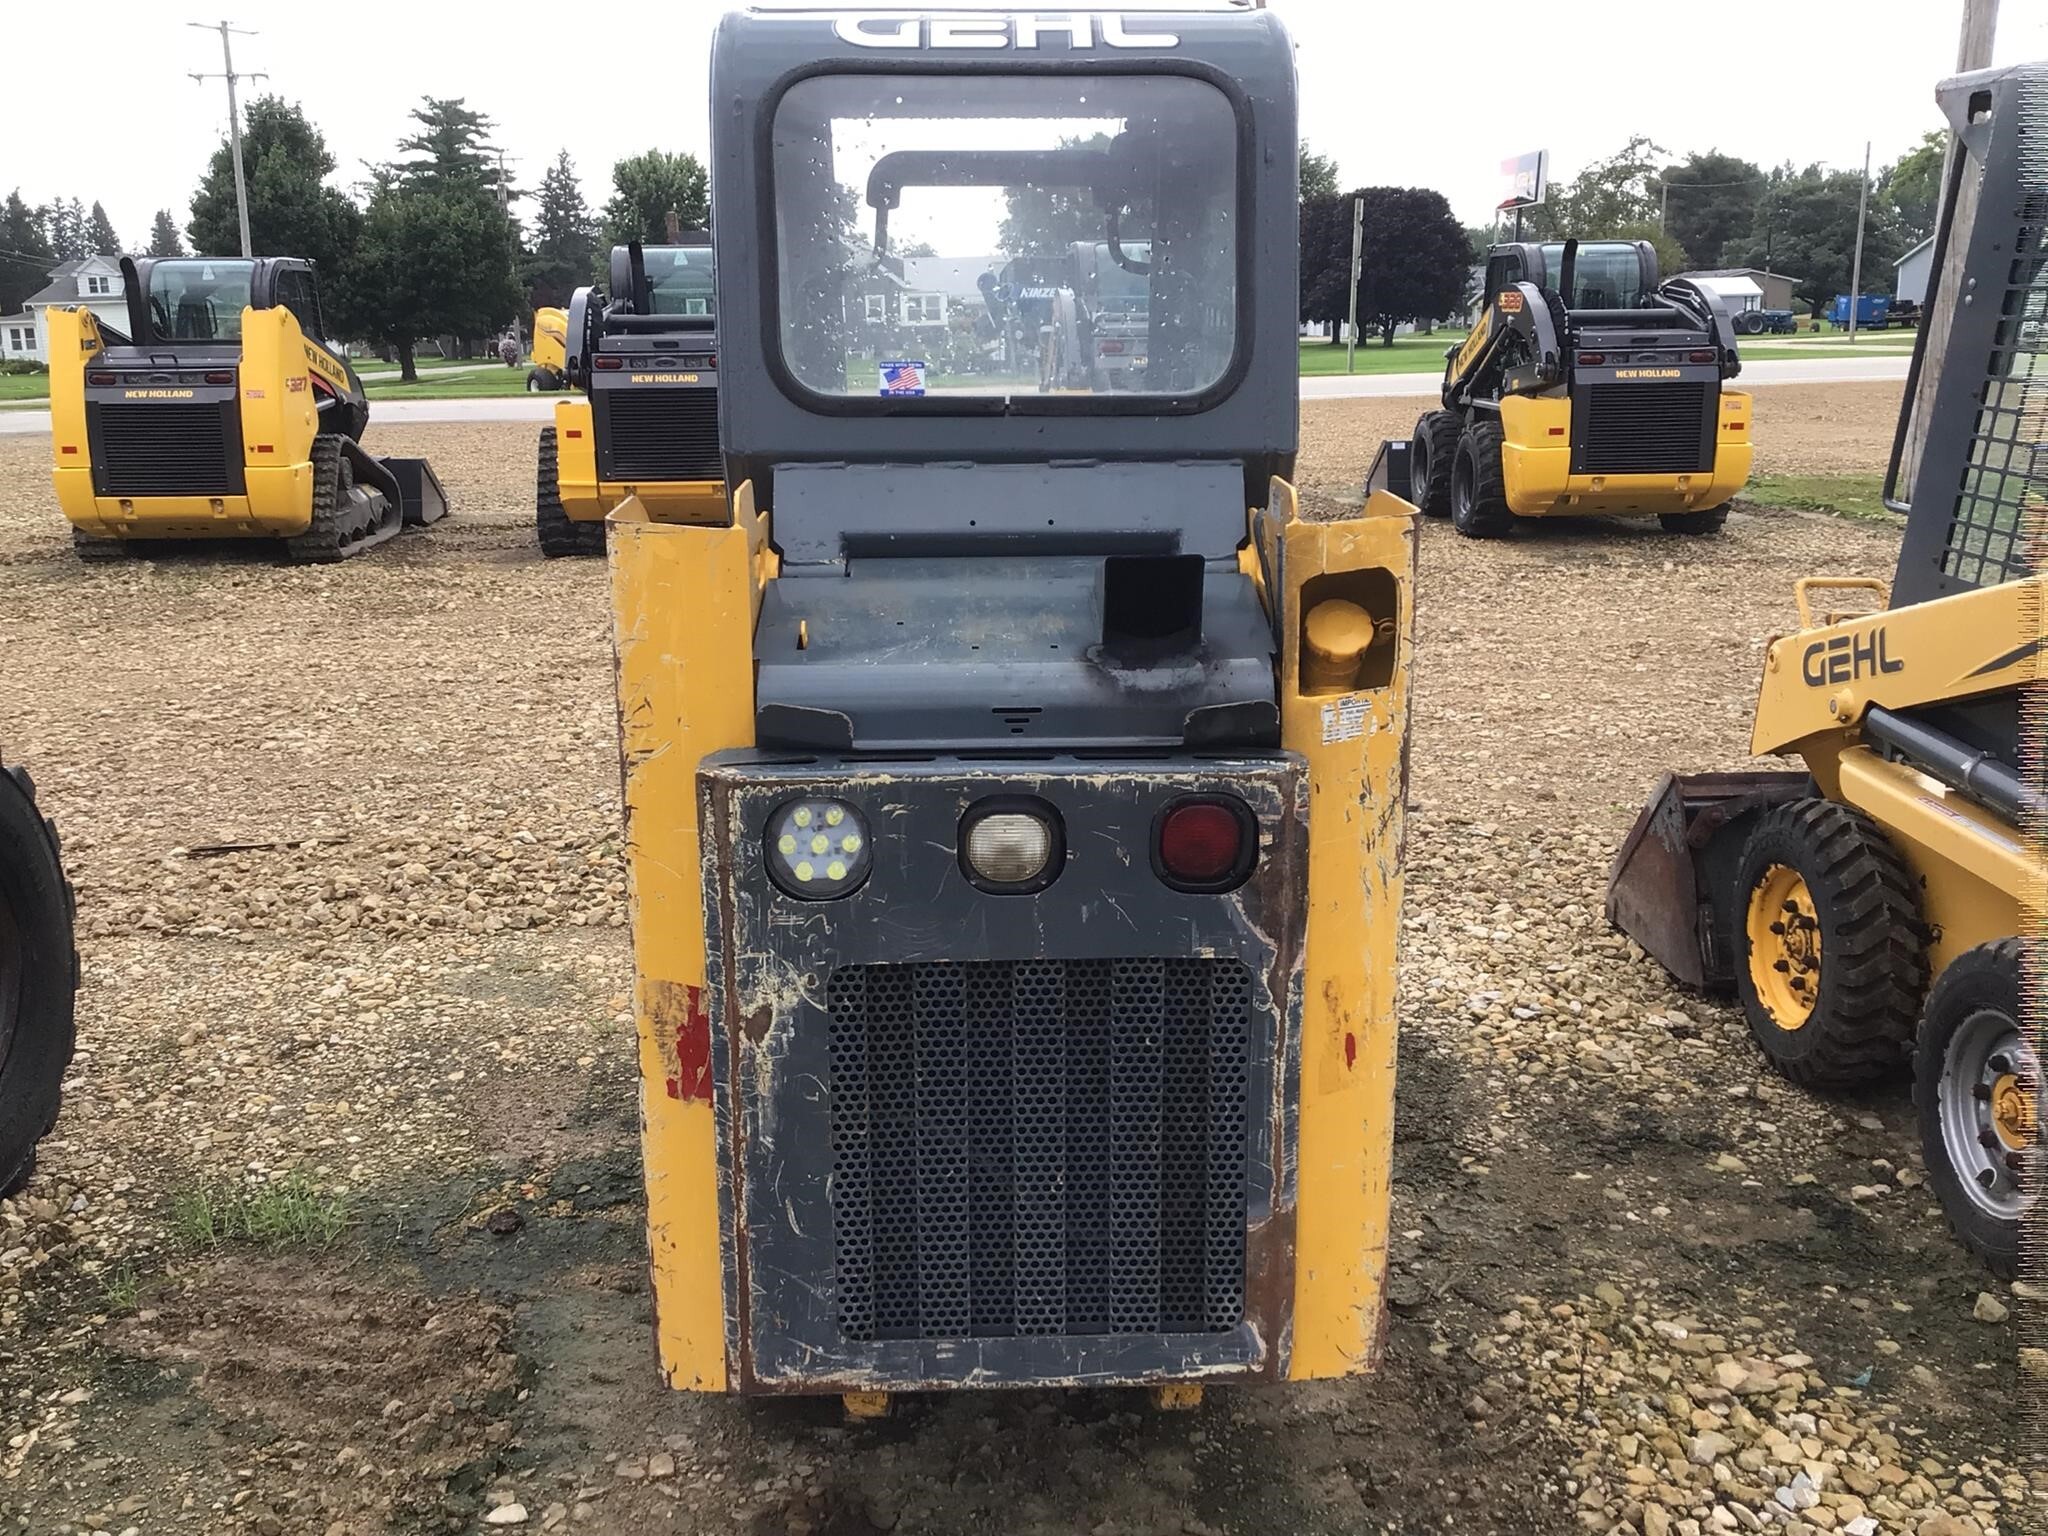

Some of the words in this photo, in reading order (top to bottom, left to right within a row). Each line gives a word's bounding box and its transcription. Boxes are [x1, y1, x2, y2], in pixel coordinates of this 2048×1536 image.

[831, 13, 1180, 49] GEHL
[631, 375, 653, 383] NEW
[654, 374, 698, 383] HOLLAND
[1615, 370, 1638, 379] NEW
[1638, 369, 1681, 378] HOLLAND
[125, 390, 147, 398] NEW
[148, 389, 194, 398] HOLLAND
[1802, 626, 1905, 687] GEHL
